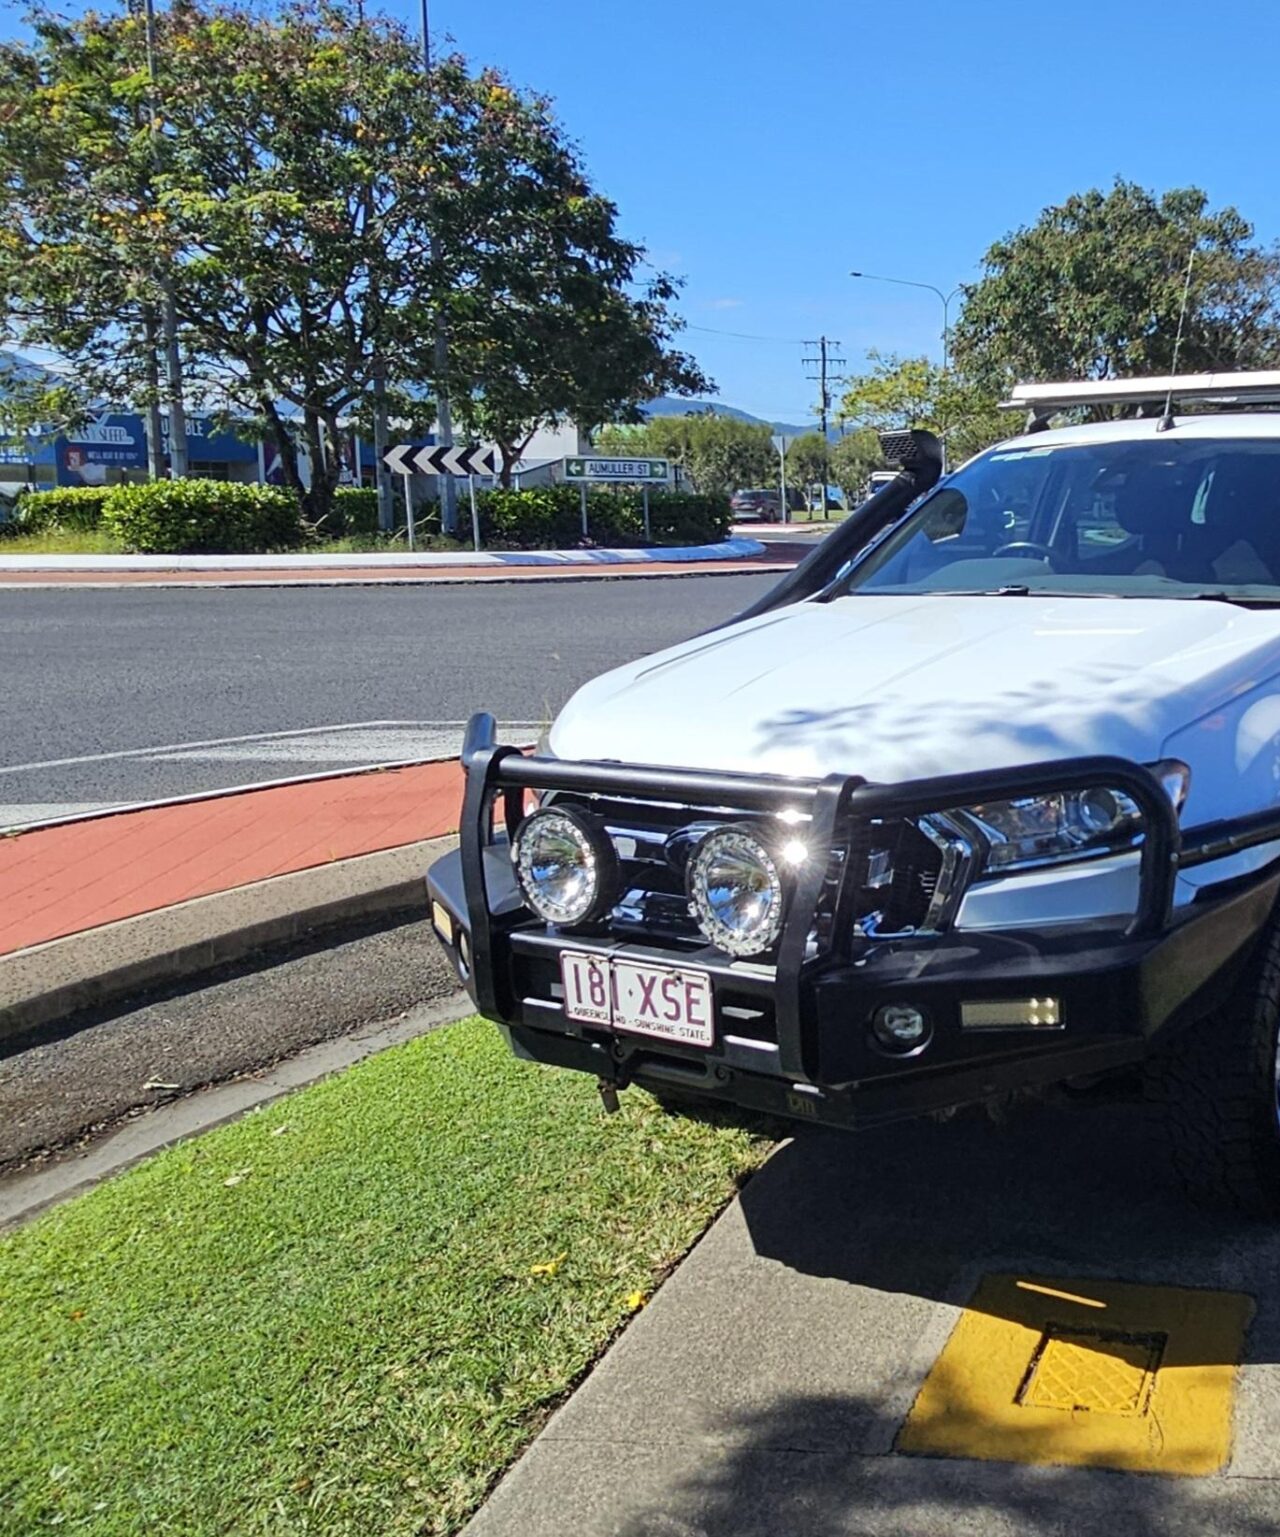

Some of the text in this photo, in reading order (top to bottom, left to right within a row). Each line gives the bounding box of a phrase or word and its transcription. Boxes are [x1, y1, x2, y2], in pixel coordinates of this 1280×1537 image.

[589, 462, 647, 475] AUMULLER ST
[573, 963, 706, 1027] 181 XSE
[574, 1006, 705, 1041] QUEENSLND SUNSHINE STATE
